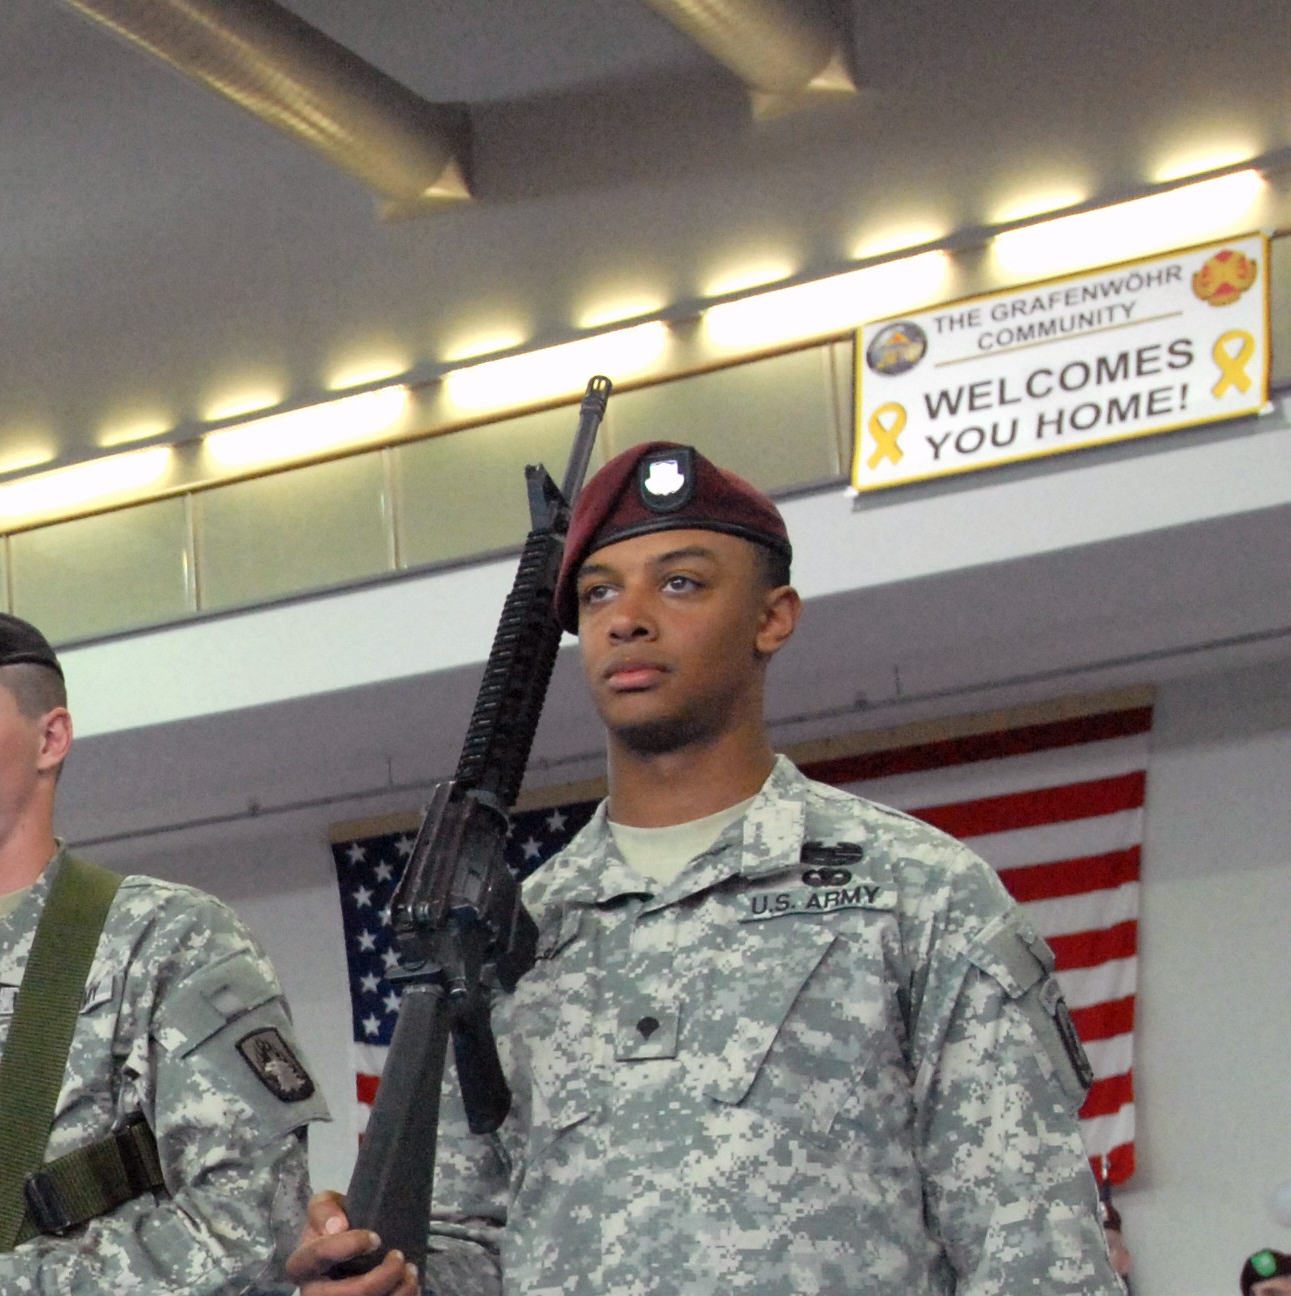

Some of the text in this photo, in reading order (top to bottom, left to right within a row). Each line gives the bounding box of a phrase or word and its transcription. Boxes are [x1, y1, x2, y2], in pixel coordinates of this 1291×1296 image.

[933, 264, 1183, 335] THE GRAFENWÖHR
[977, 300, 1137, 350] COMMUNITY
[924, 338, 1195, 420] WELCOMES
[925, 383, 1189, 461] YOU HOME!
[751, 885, 880, 915] U.S. ARMY
